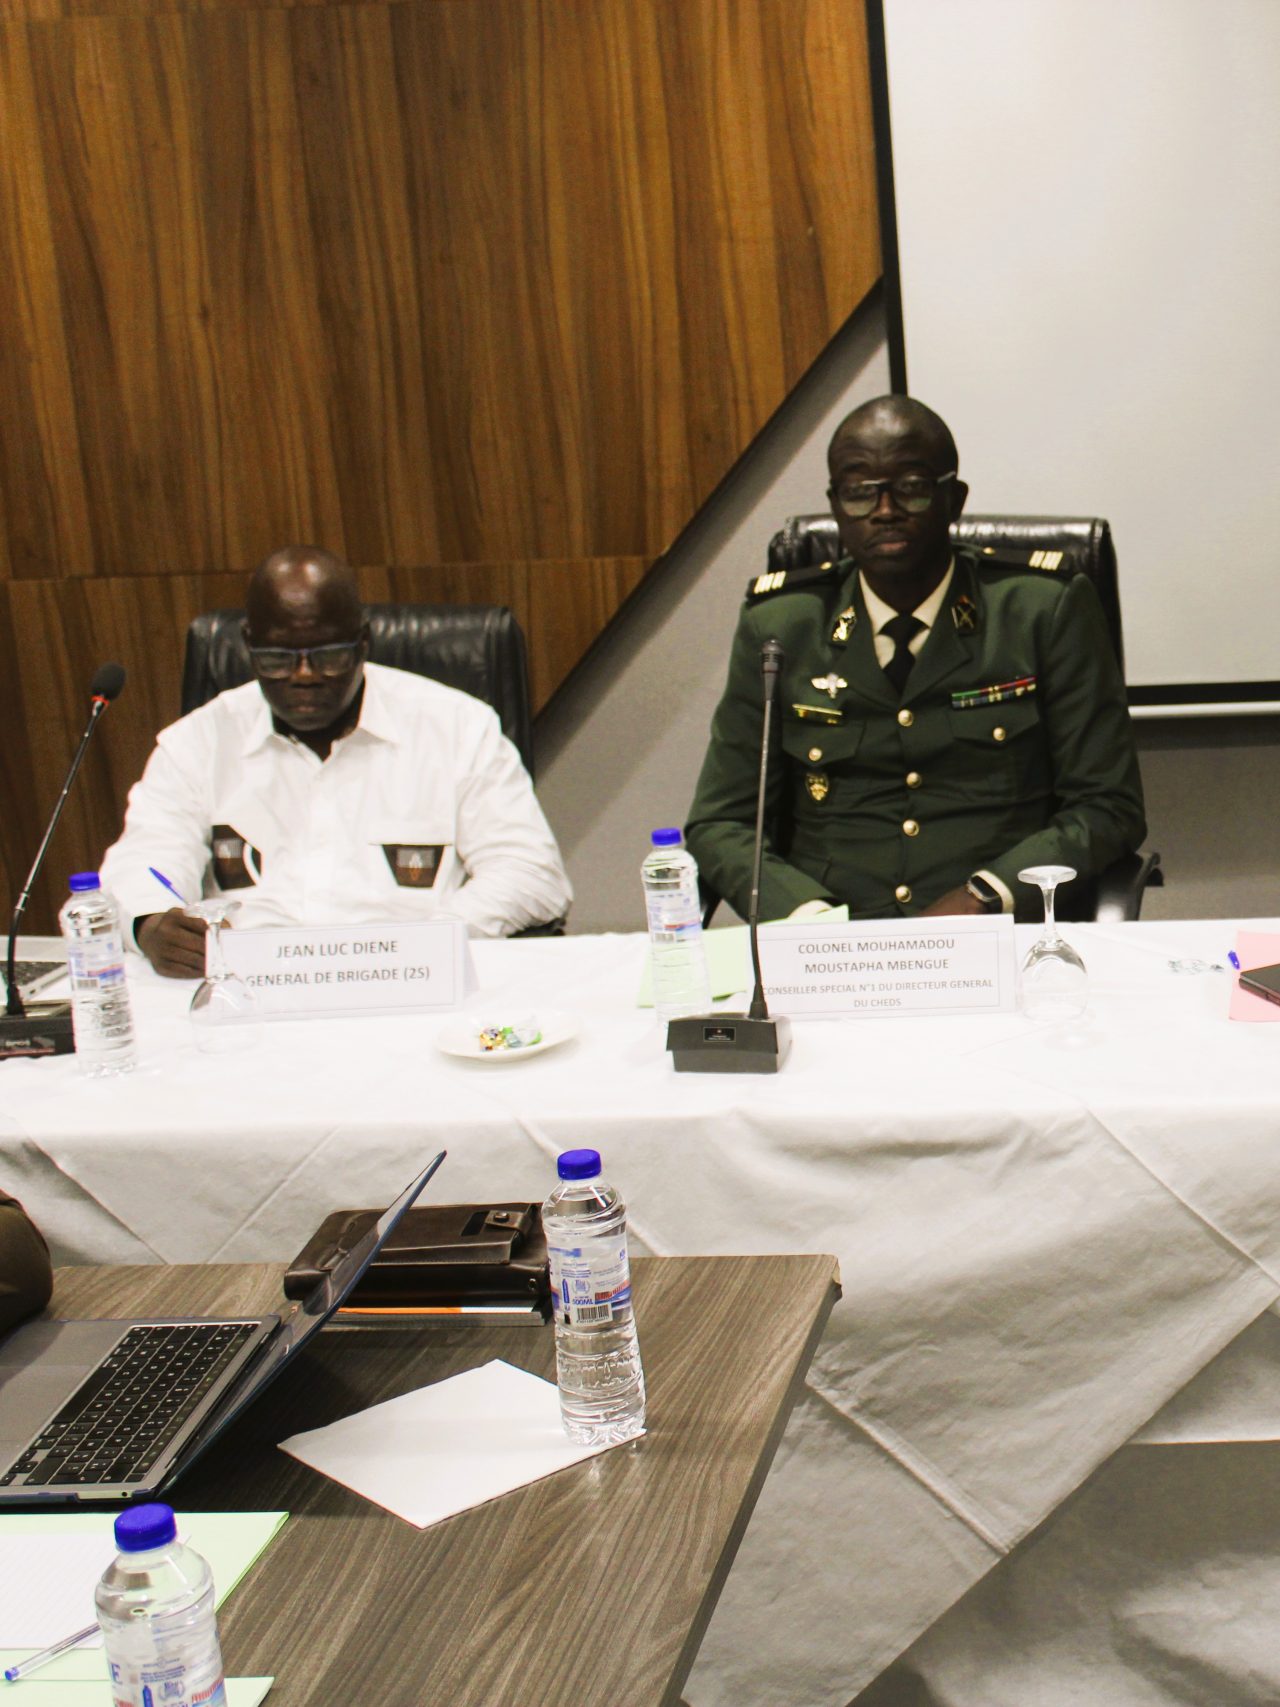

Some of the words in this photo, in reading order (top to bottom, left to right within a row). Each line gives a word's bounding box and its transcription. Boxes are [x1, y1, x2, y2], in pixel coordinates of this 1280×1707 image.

[276, 944, 314, 959] JEAN
[320, 943, 349, 956] LUC
[353, 940, 398, 955] DIENE
[798, 942, 853, 954] COLONEL
[857, 939, 955, 952] MOUHAMADOU
[804, 961, 884, 974] MOUSTAPHA
[887, 958, 949, 971] MBENGUE
[246, 972, 310, 987] GENERAL
[315, 971, 332, 984] DE
[337, 968, 398, 983] BRIGADE
[403, 966, 430, 981] (2S)
[819, 983, 857, 994] SPECIAL
[879, 982, 892, 992] DU
[895, 980, 947, 991] DIRECTEUR
[950, 979, 993, 990] GENERAL
[854, 999, 868, 1008] DU
[870, 998, 902, 1007] CHEDS
